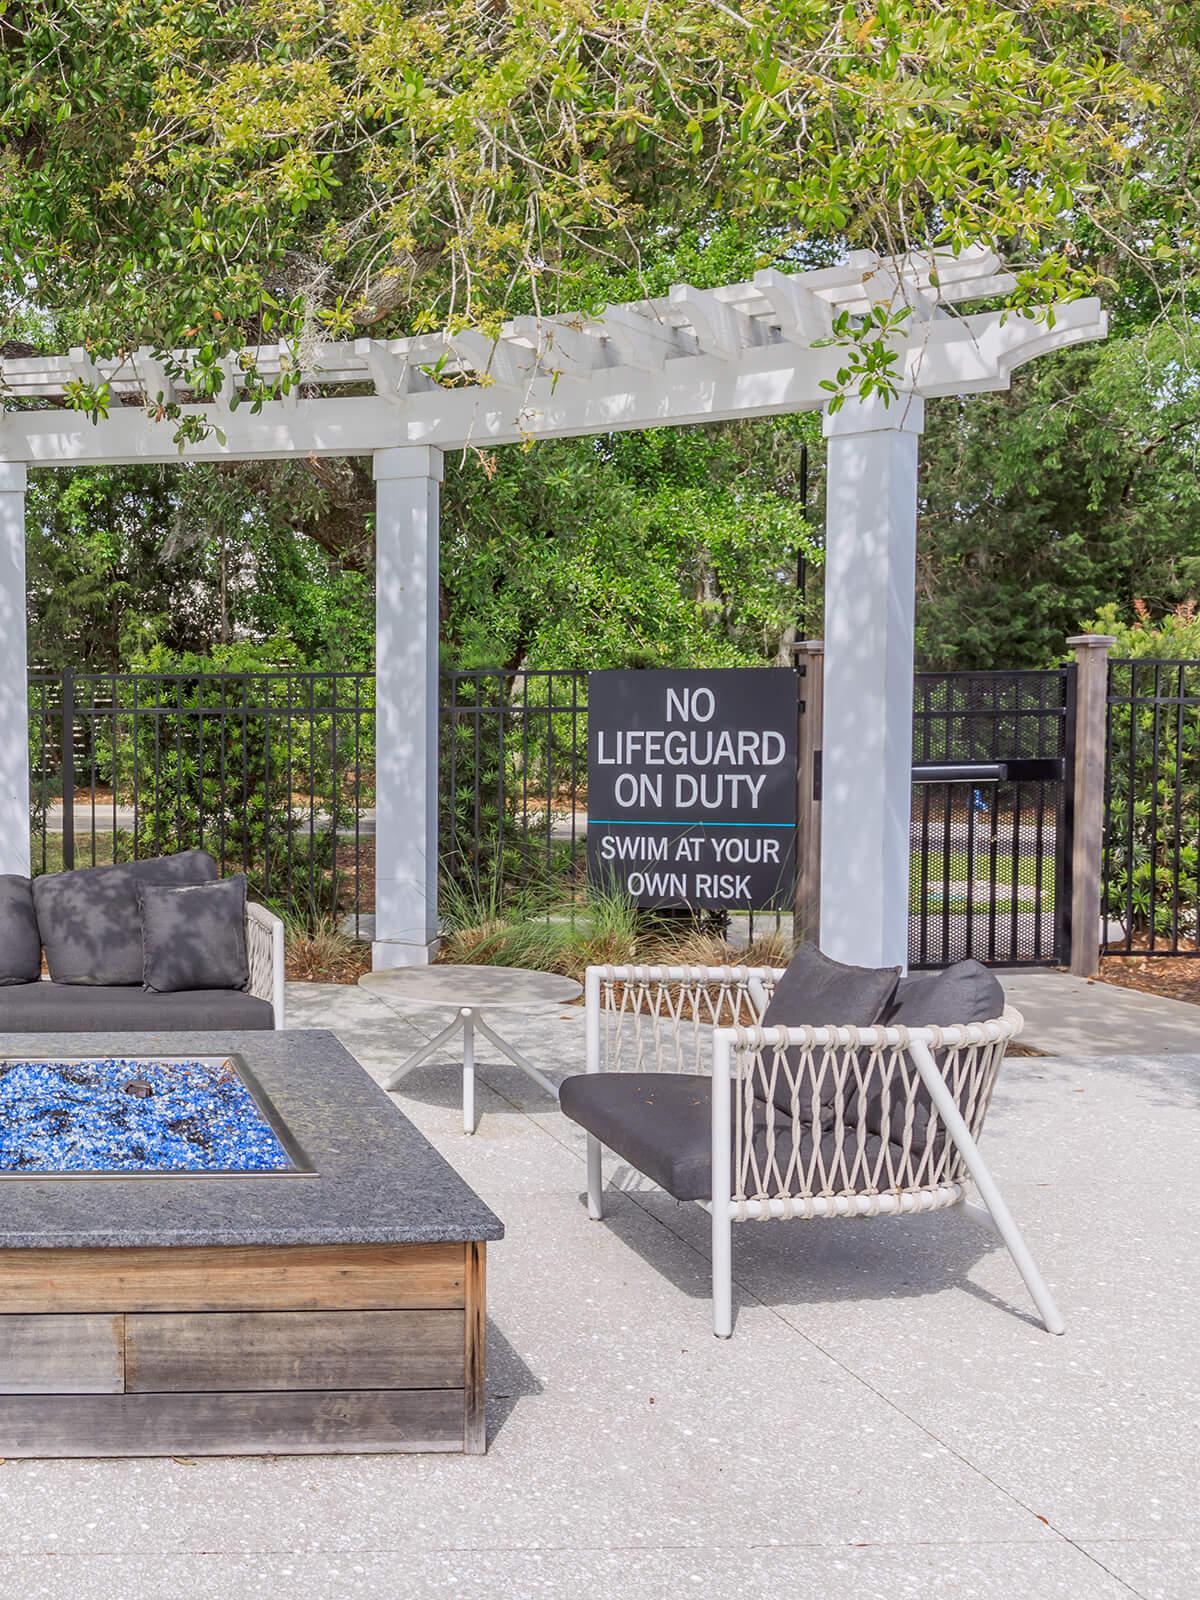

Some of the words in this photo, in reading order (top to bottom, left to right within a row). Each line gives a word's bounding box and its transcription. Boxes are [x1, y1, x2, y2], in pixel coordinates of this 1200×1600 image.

[666, 688, 715, 722] NO
[598, 731, 786, 765] LIFEGUARD
[615, 774, 662, 807] ON
[676, 774, 767, 808] DUTY
[601, 836, 668, 861] SWIM
[675, 838, 704, 862] AT
[711, 838, 780, 863] YOUR
[627, 872, 687, 897] OWN
[696, 874, 752, 899] RISK
